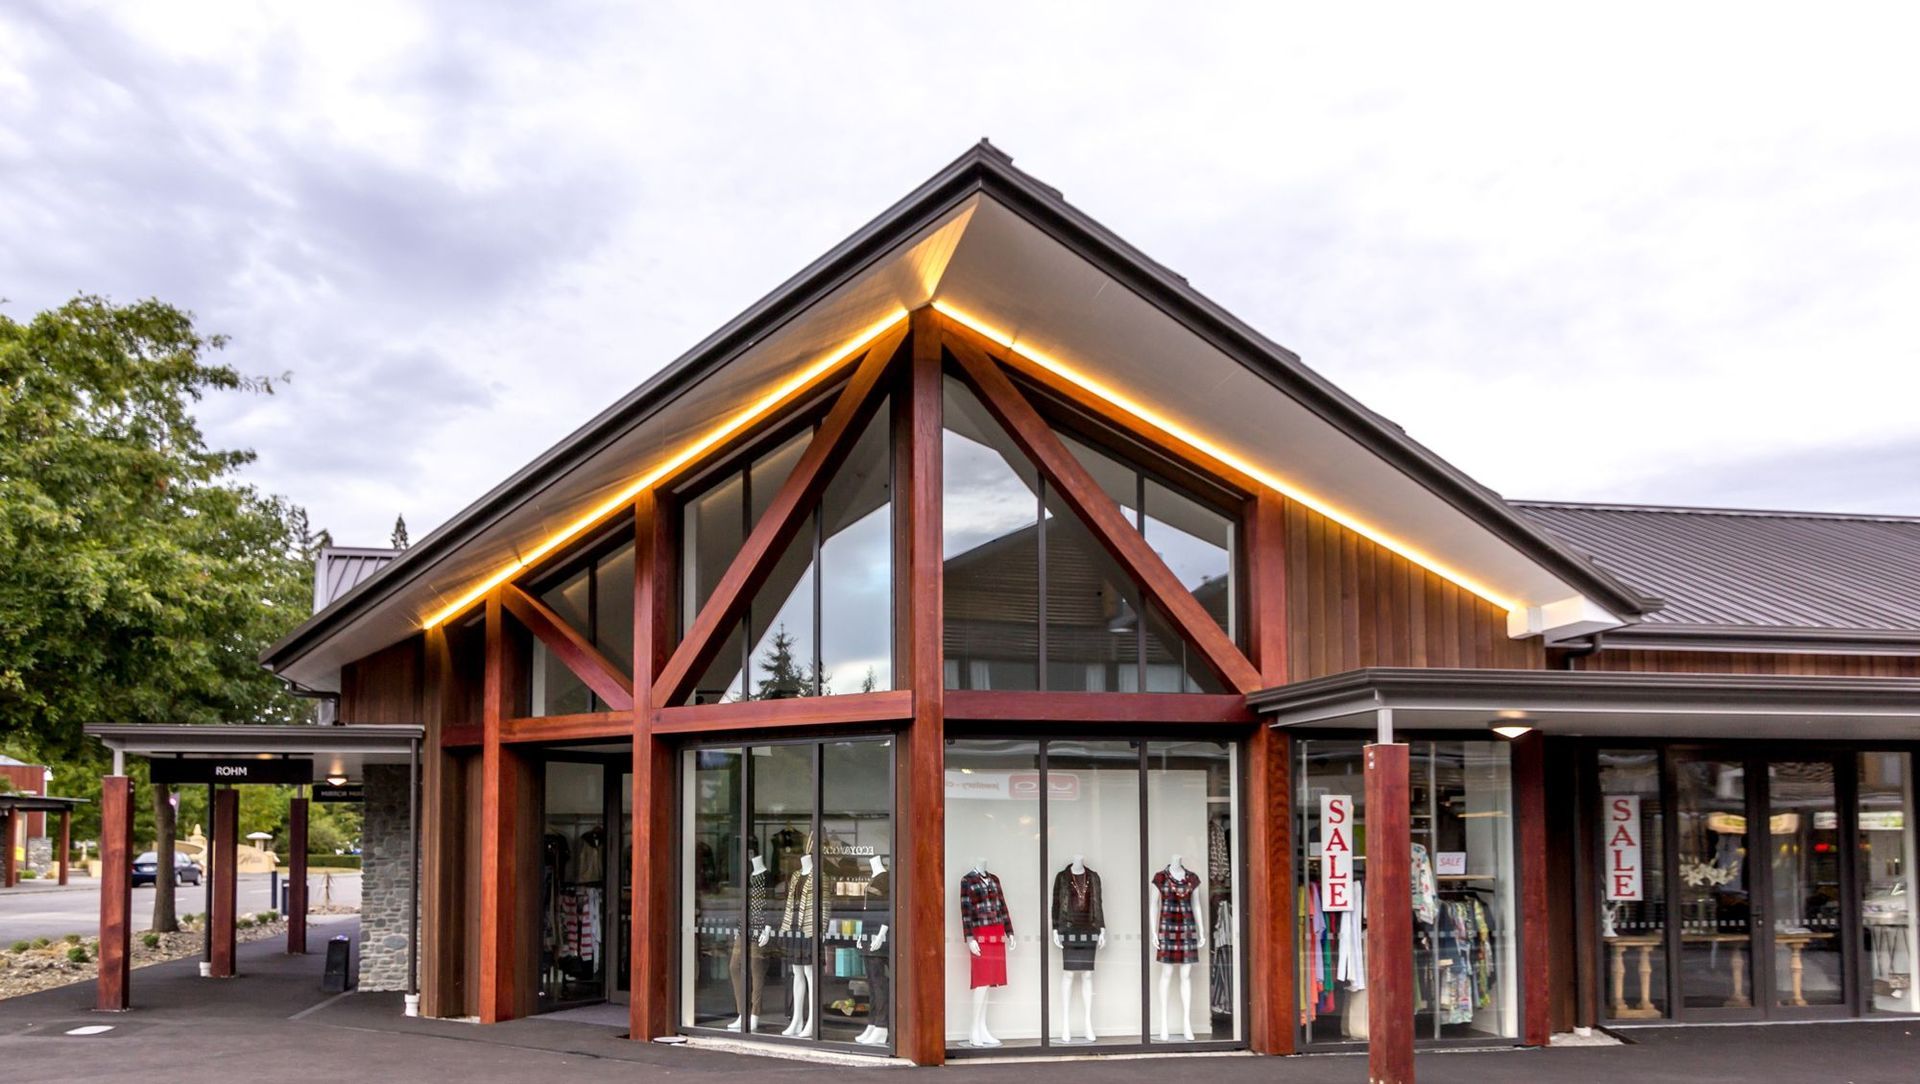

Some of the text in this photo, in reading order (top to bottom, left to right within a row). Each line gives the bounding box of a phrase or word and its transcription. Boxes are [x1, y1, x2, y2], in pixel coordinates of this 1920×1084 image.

[215, 766, 248, 776] ROHM
[1325, 799, 1349, 907] SALE
[1438, 857, 1461, 866] SALE
[1609, 799, 1636, 897] SALE
